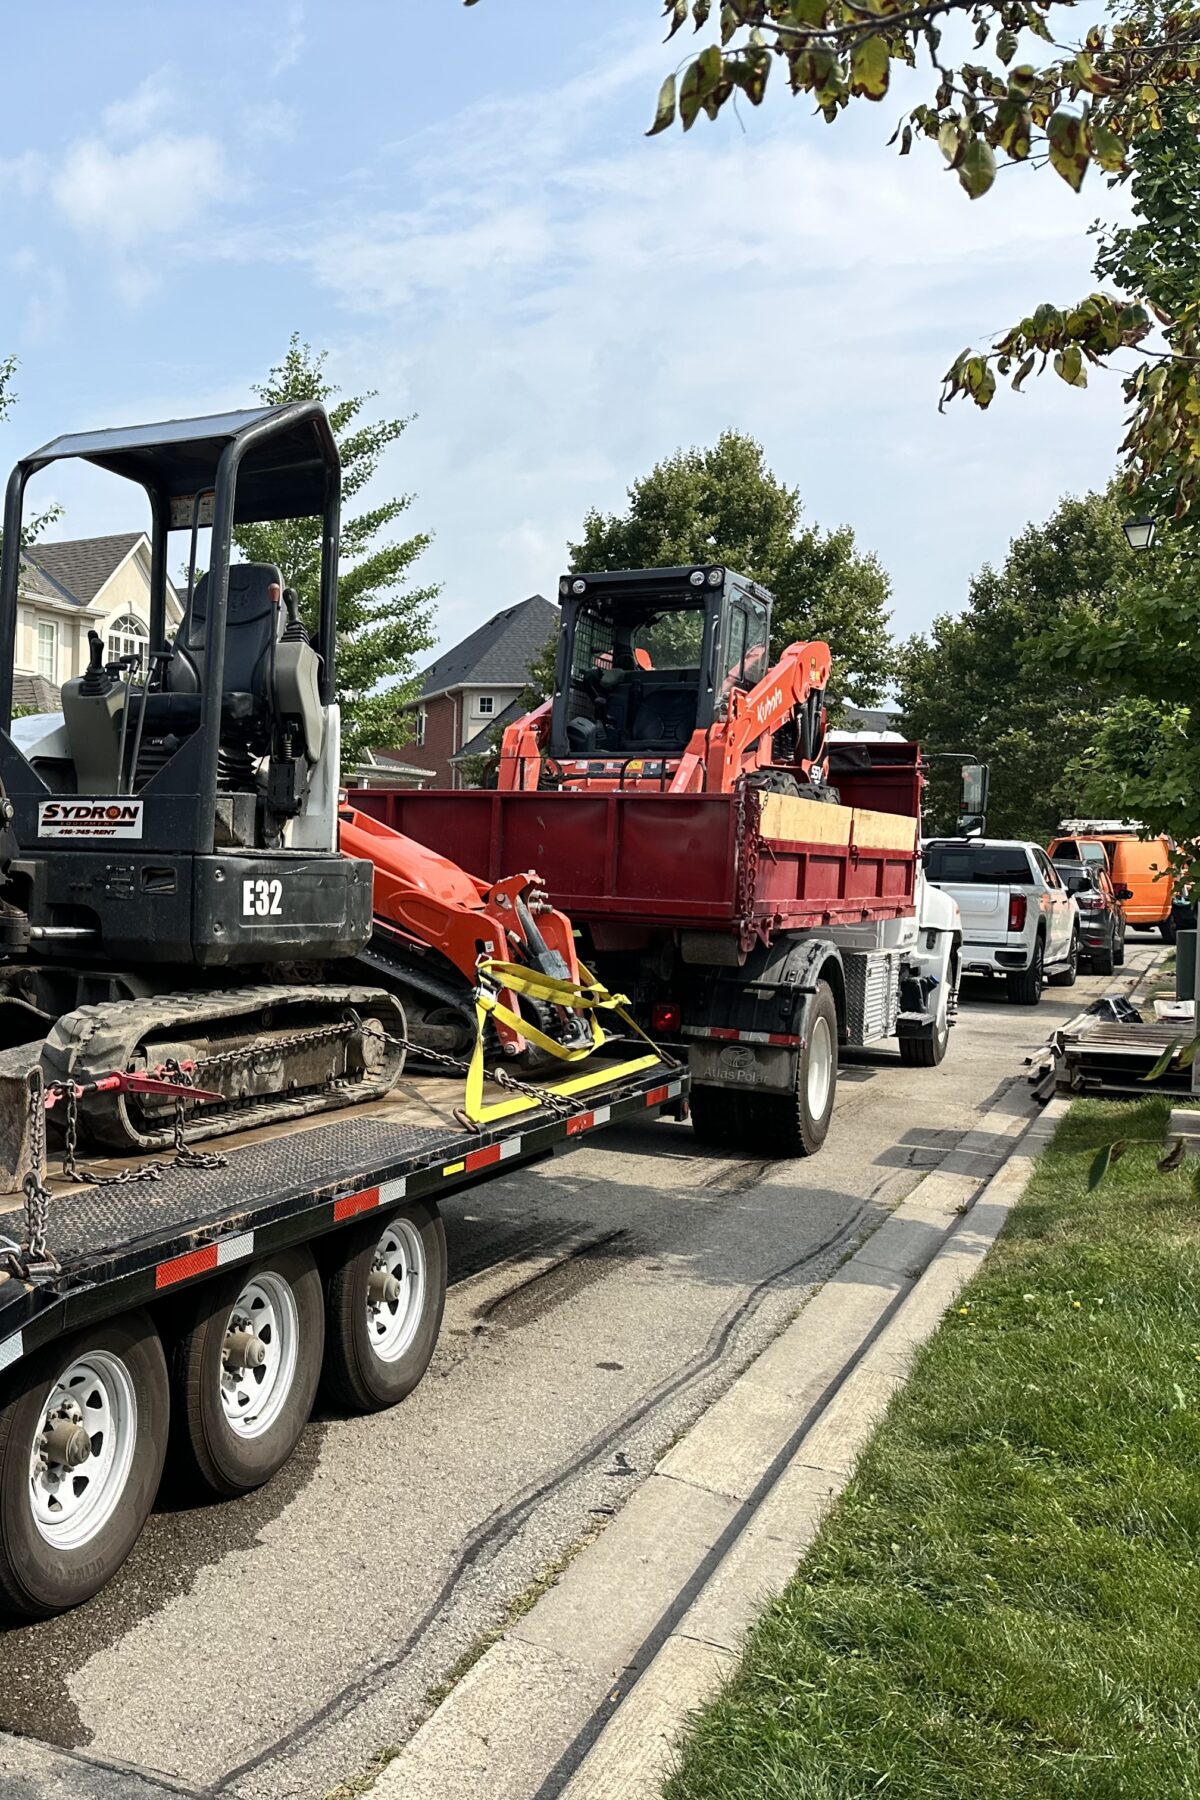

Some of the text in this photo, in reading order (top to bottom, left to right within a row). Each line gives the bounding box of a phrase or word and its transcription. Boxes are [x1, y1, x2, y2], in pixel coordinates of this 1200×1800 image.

[756, 686, 783, 724] Kubota
[42, 803, 140, 820] SYDRON
[242, 879, 283, 916] E32
[704, 1067, 768, 1083] Atlas Polar
